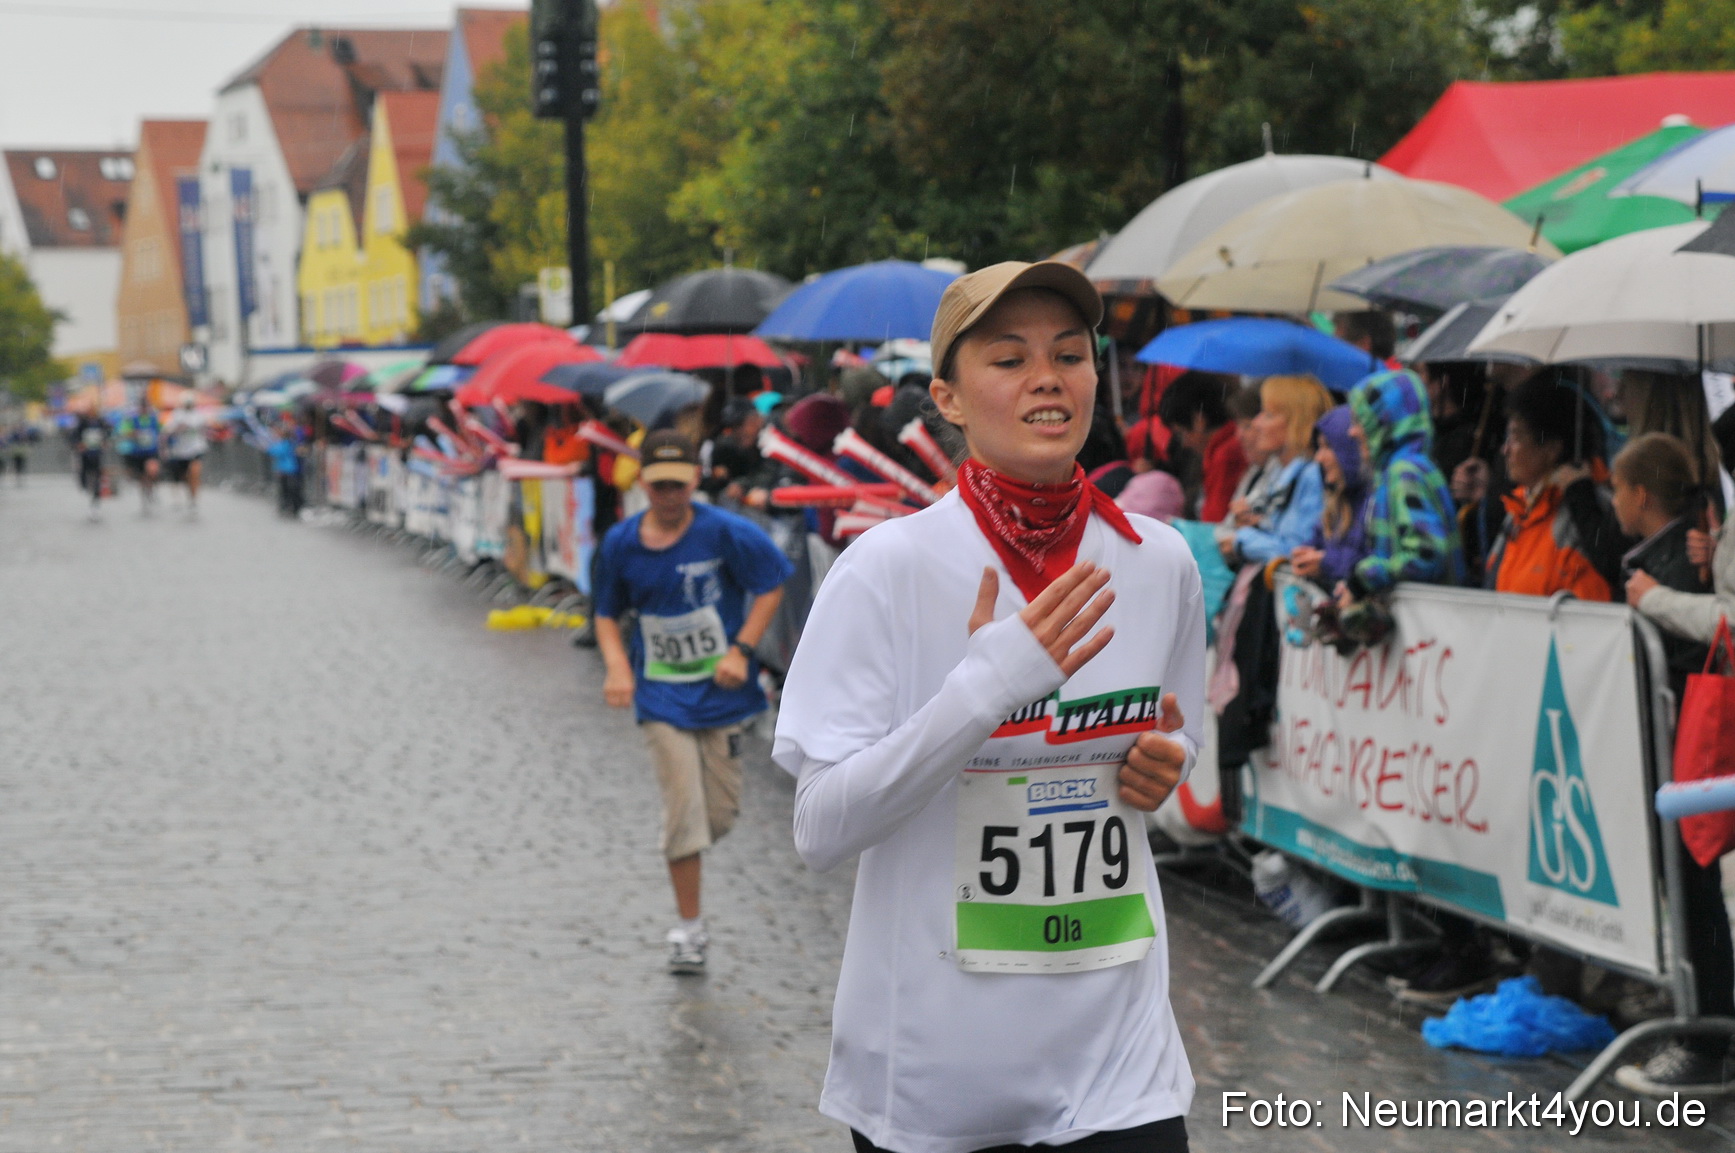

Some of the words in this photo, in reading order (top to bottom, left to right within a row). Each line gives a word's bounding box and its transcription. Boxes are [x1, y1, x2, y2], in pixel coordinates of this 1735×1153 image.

[650, 627, 716, 662] 5015
[1058, 692, 1157, 736] ITALIA
[1012, 753, 1082, 768] ITALIENISCHE
[1027, 778, 1097, 803] BOCK
[979, 816, 1130, 897] 5179
[1044, 915, 1082, 944] Ola
